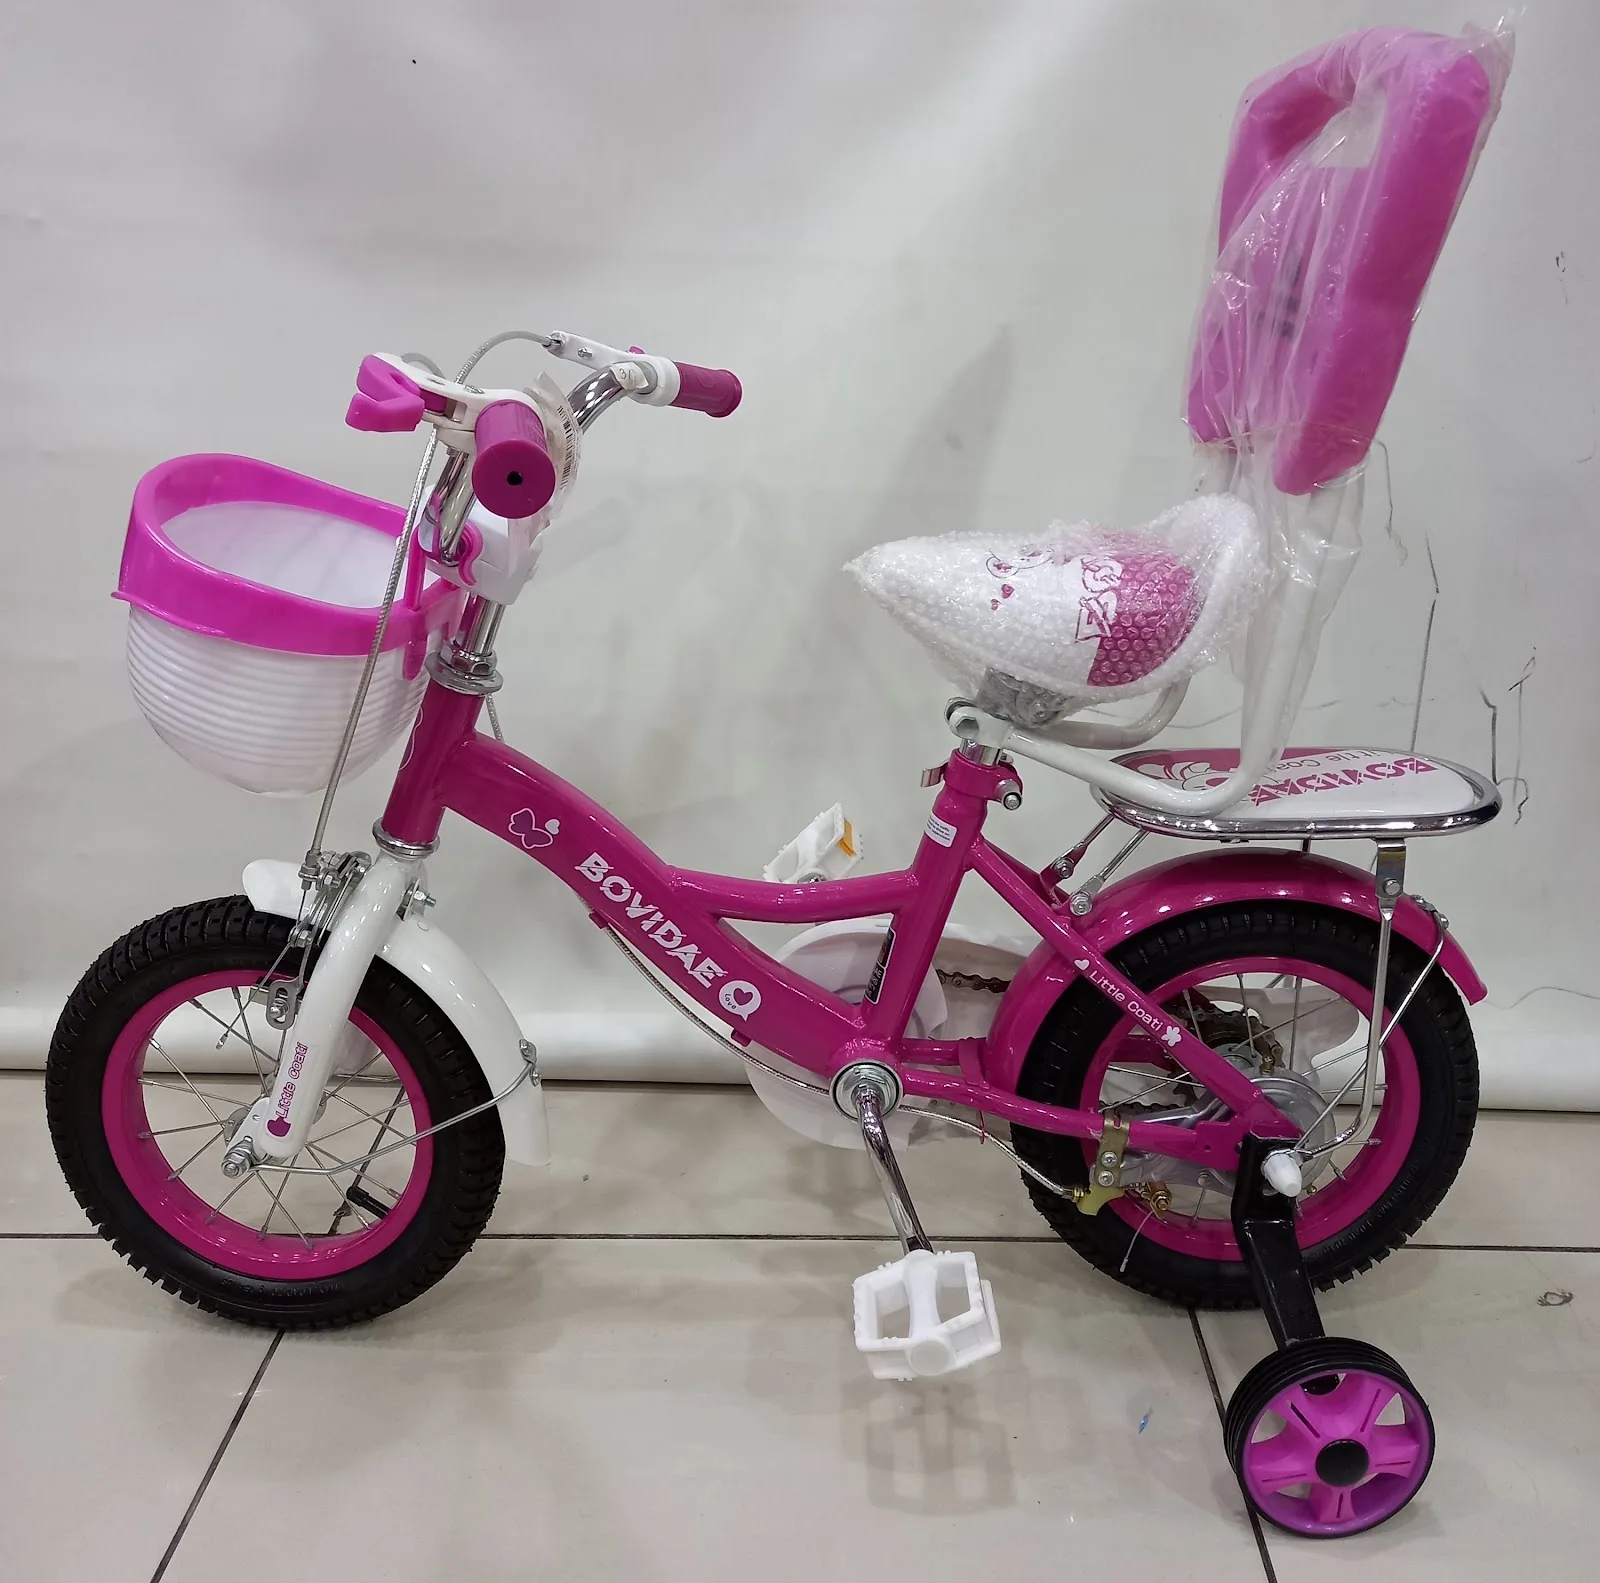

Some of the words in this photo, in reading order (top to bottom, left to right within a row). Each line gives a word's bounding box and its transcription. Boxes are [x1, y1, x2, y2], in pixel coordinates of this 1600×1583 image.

[1248, 757, 1438, 806] BOVIDAE
[1325, 749, 1388, 761] ittle
[574, 852, 728, 988] BOVIDAE
[1089, 970, 1126, 1002] Little
[1127, 1000, 1164, 1031] Coati
[275, 1081, 297, 1119] Little
[288, 1041, 309, 1080] Coati
